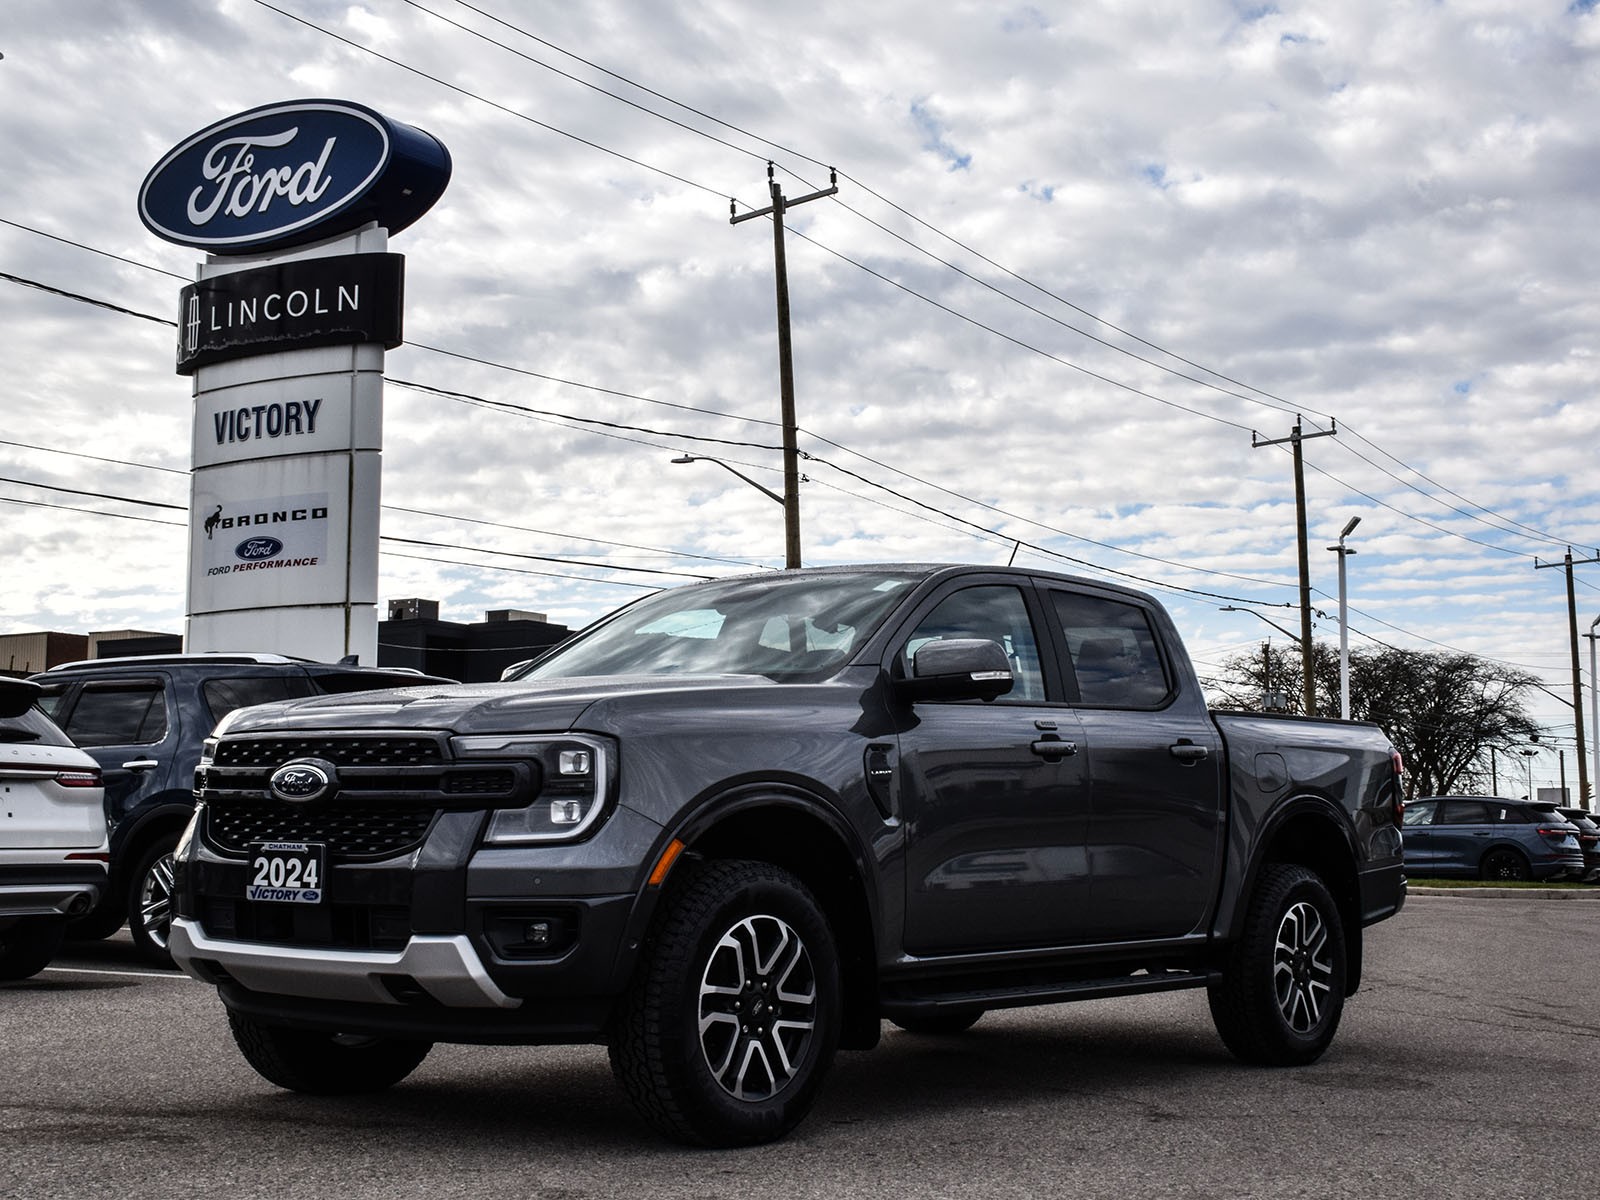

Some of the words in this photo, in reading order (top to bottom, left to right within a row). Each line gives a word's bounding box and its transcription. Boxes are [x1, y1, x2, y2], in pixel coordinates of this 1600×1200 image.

[187, 127, 336, 225] Ford
[211, 284, 360, 331] LINCOLN
[214, 398, 322, 444] VICTORY
[221, 507, 328, 529] BRONCO
[244, 540, 273, 557] Ford
[207, 565, 231, 576] FORD
[232, 557, 318, 572] PERFORMANCE
[253, 857, 318, 888] 2024
[250, 885, 300, 901] VICTORY
